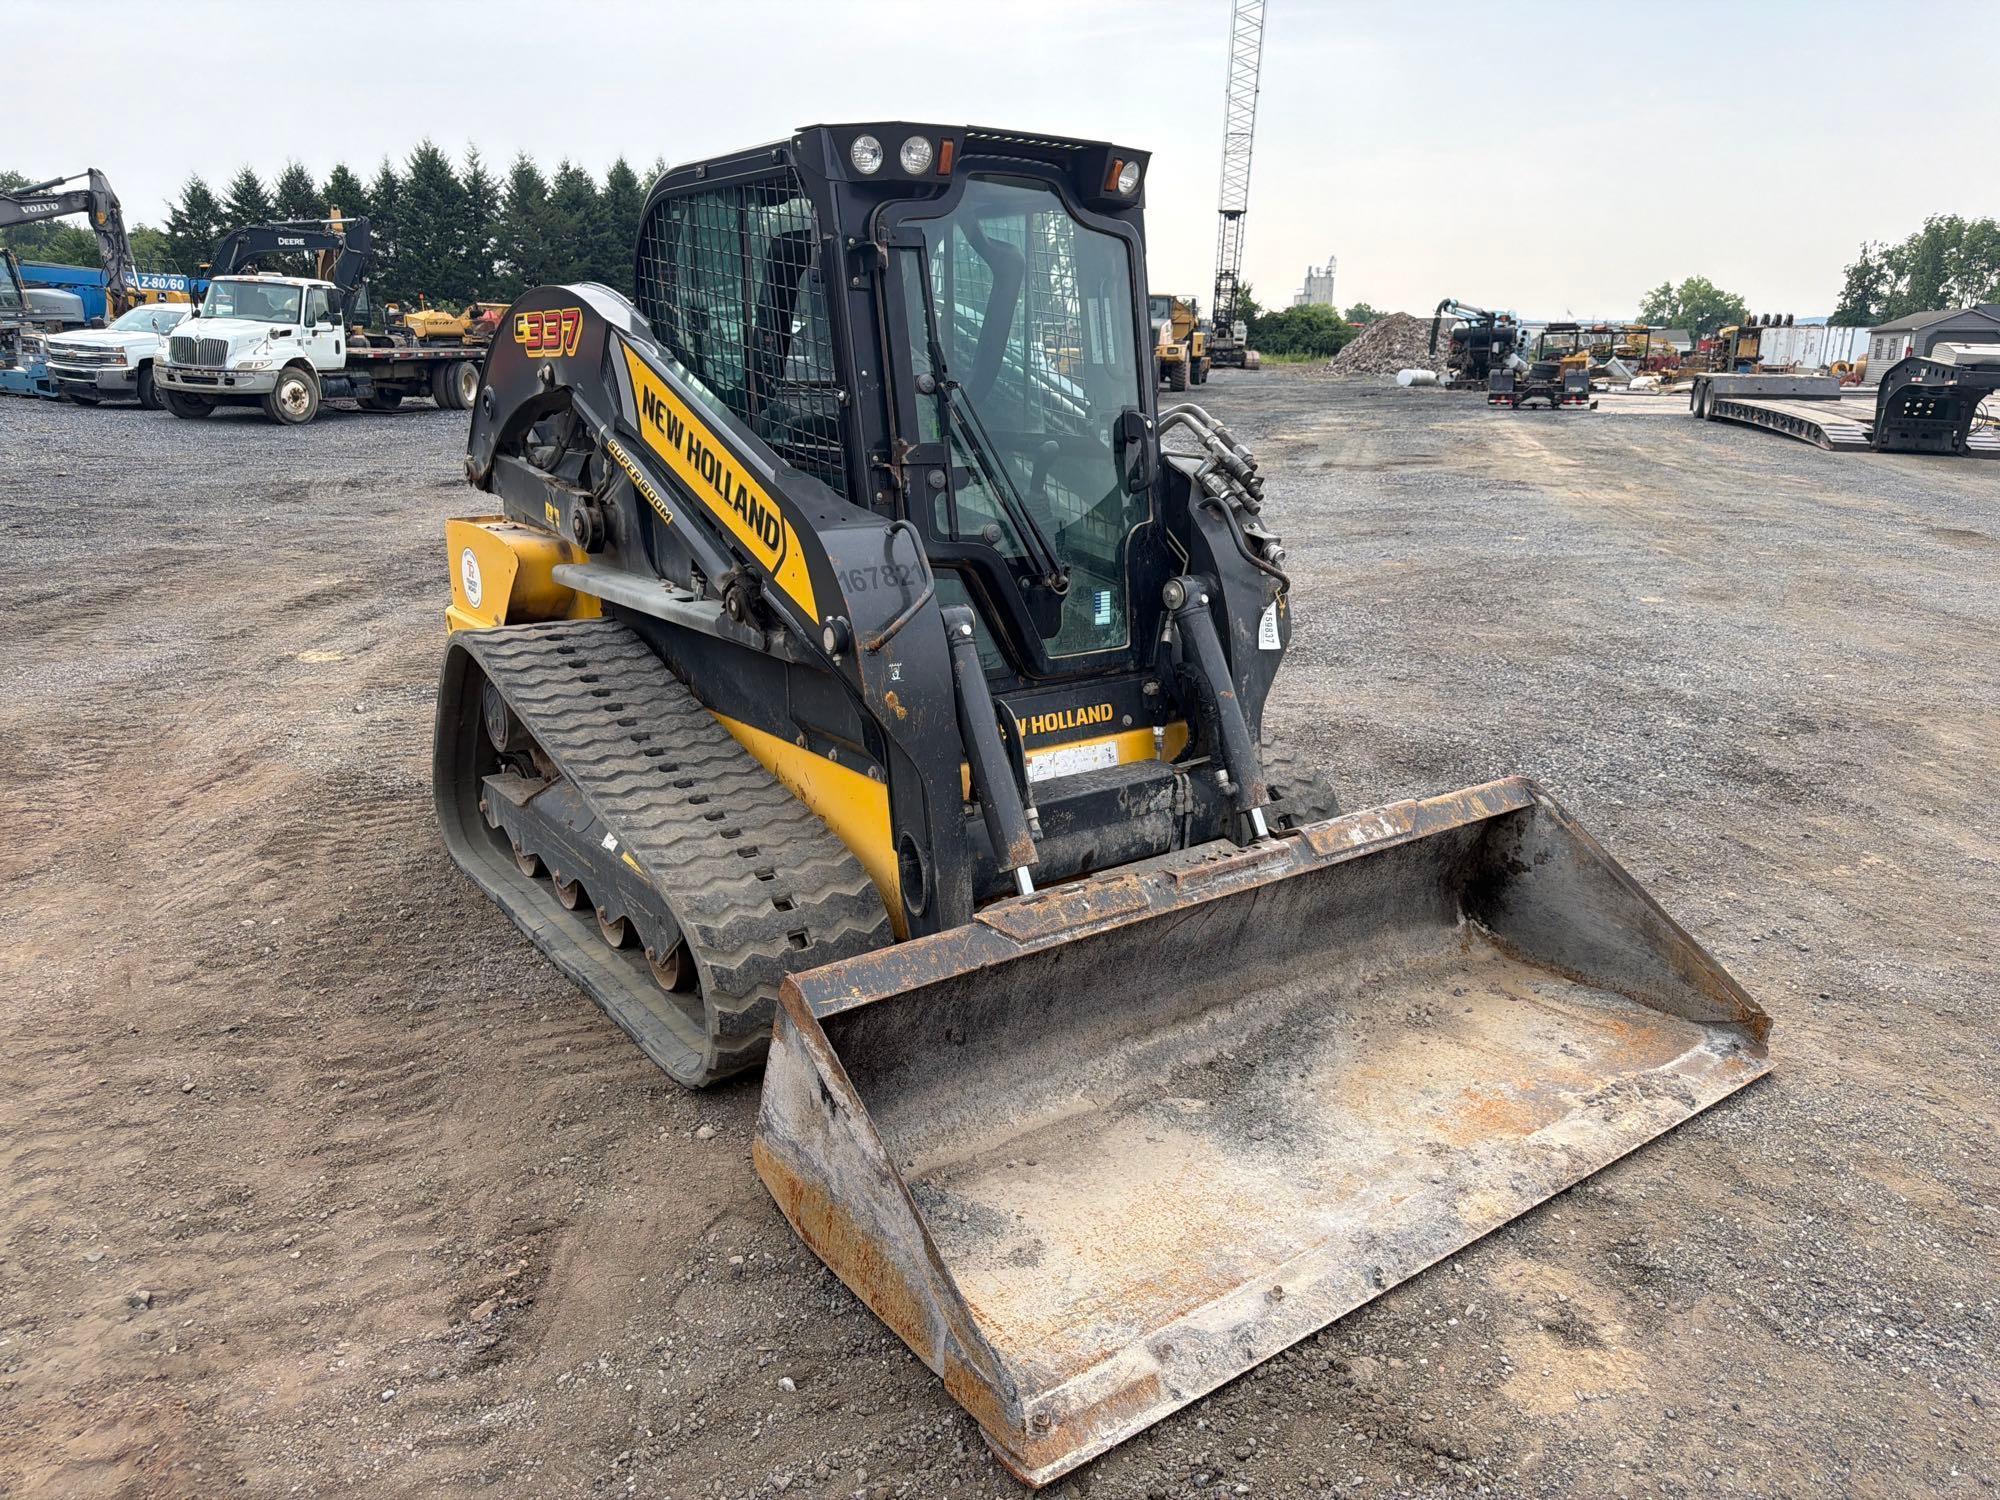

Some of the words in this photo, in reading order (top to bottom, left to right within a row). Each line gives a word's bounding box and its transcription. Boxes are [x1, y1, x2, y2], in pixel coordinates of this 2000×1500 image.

[20, 203, 59, 214] VOLVO
[278, 237, 305, 246] DEERE
[141, 276, 185, 290] Z-80/60
[607, 438, 643, 486] SUPER
[639, 479, 674, 526] BOOM
[642, 384, 685, 451] NEW
[686, 429, 780, 551] HOLLAND
[1264, 611, 1275, 644] 159837
[1031, 703, 1114, 735] HOLLAND
